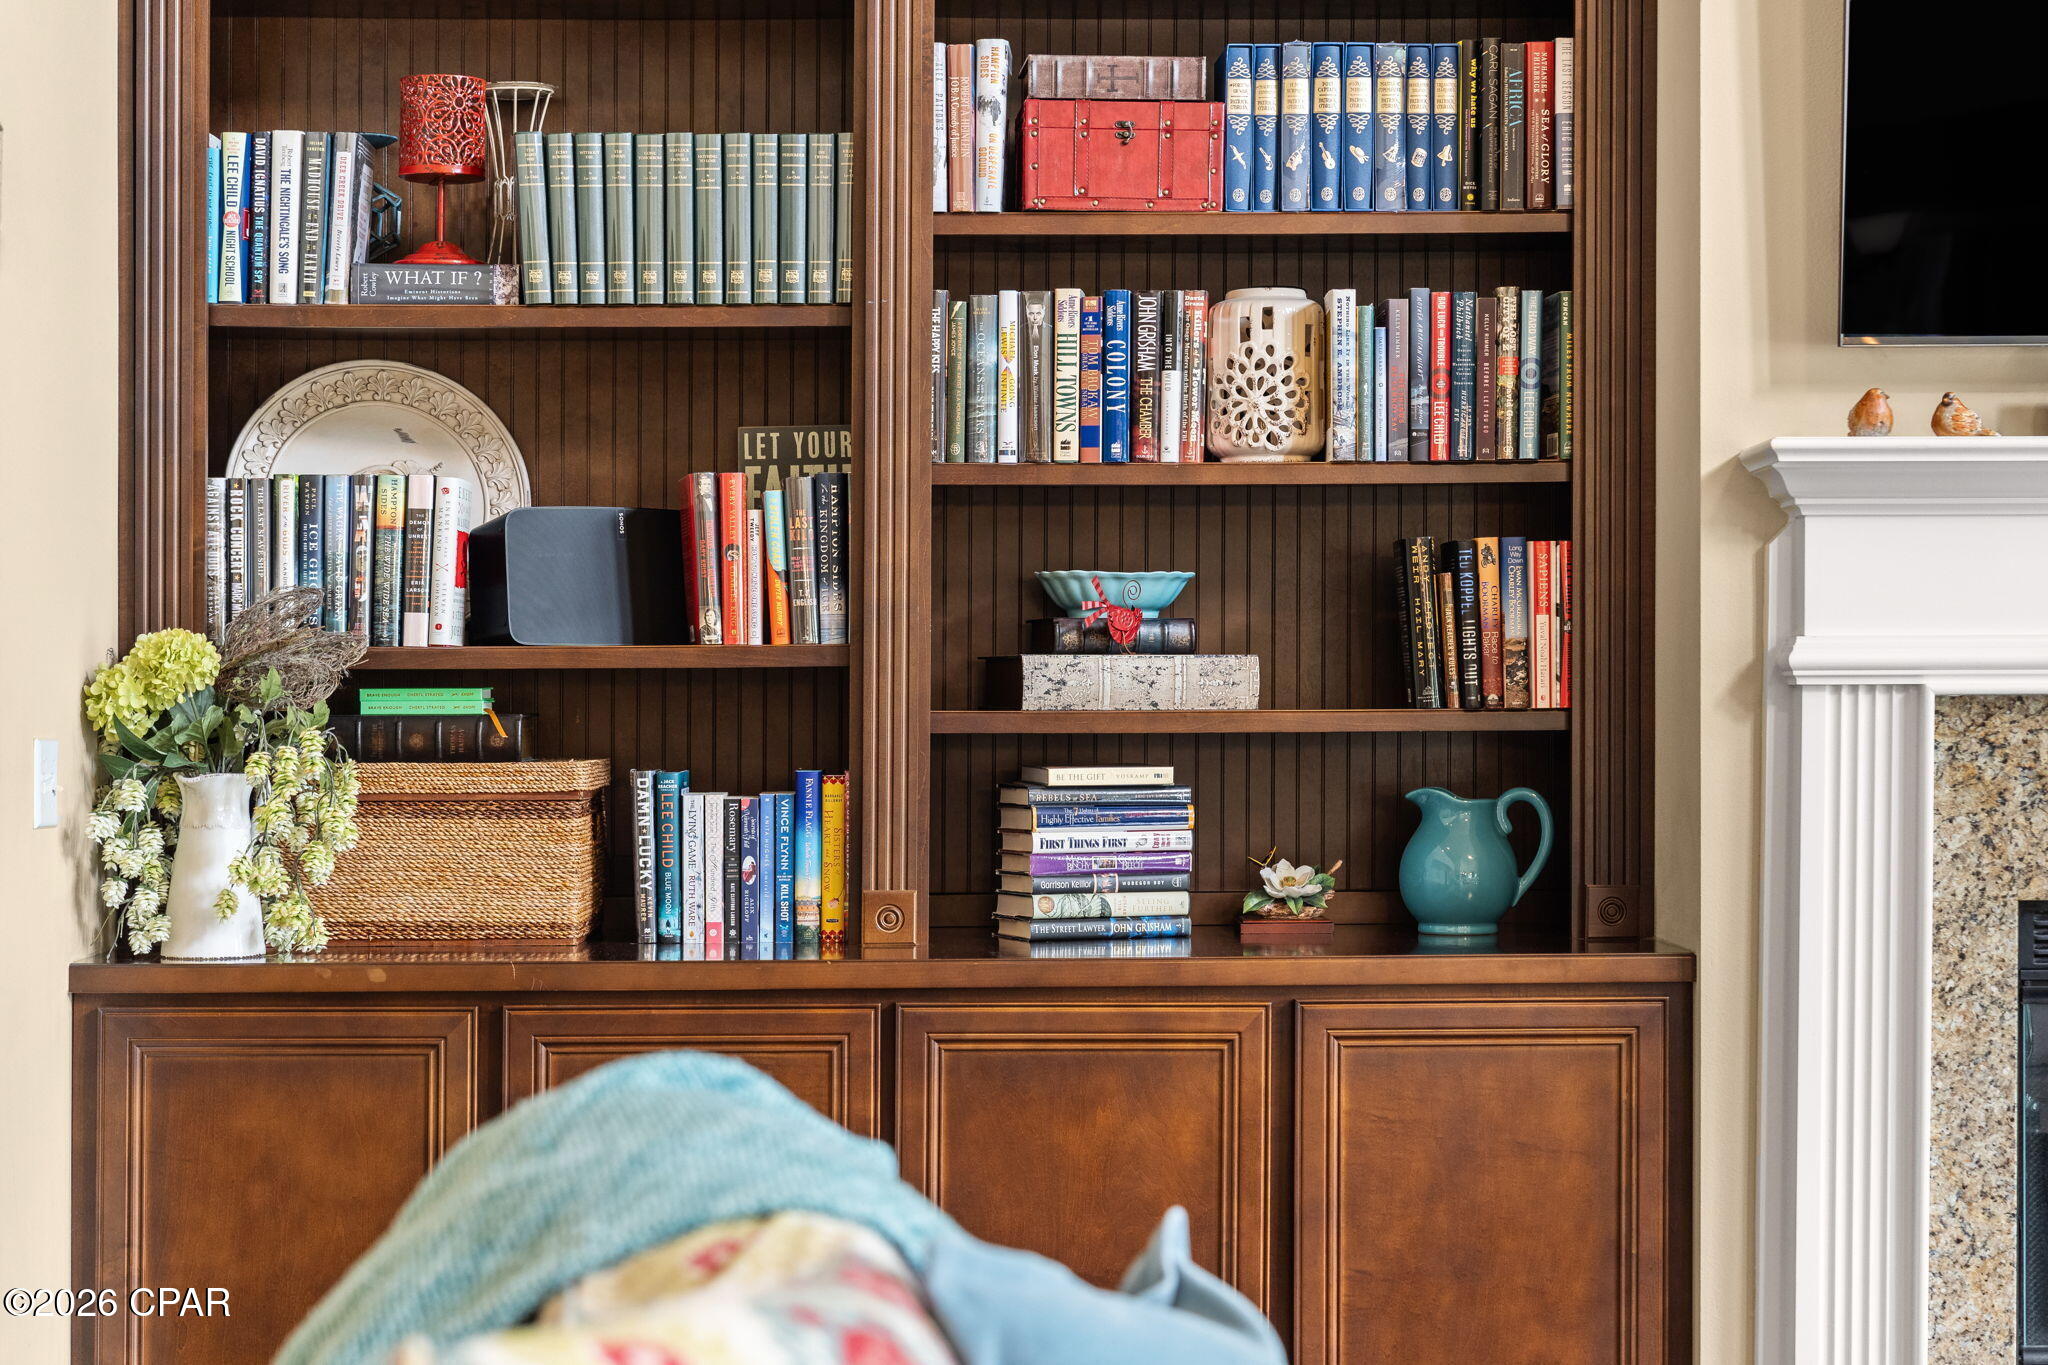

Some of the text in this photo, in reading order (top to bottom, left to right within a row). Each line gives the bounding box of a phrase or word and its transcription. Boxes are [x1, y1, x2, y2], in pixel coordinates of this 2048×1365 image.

[979, 55, 990, 79] SIDES
[990, 46, 1001, 84] HAMPTON
[1488, 44, 1498, 119] CARL SAGAN
[1468, 58, 1478, 128] why we hate us
[1508, 67, 1523, 127] AFRICA
[1561, 42, 1573, 176] THE LAST SEASON ERIC BLEHM
[227, 155, 239, 174] LEE
[1540, 109, 1550, 184] SEA of GLORY
[225, 176, 239, 208] CHILD
[253, 138, 267, 284] DAVID IGNATIUS THE QUANTUM SPY
[225, 230, 236, 253] NIGHT
[278, 169, 292, 274] THE NIGHTINGALE'S SONG
[303, 157, 322, 284] MADHOUSE END EARTH
[224, 255, 236, 287] SCHOOL
[360, 273, 369, 297] Robert
[369, 271, 379, 297] Cowley
[384, 270, 482, 286] WHAT IF ?
[1138, 295, 1157, 322] JOHN
[1455, 299, 1464, 340] Philbrick
[1465, 297, 1474, 342] Nathaniel
[1502, 296, 1510, 323] CITY
[1509, 296, 1517, 352] THE LOST
[1137, 324, 1157, 372] GRISHAM
[1165, 334, 1173, 353] INTO
[1183, 342, 1191, 366] Murders
[1502, 326, 1510, 342] OF
[1055, 333, 1078, 433] HILL TOWNS
[1087, 340, 1099, 420] TOM BROKAW
[1106, 339, 1126, 414] COLONY
[1164, 372, 1172, 392] WILD
[1165, 355, 1173, 369] THE
[1523, 296, 1537, 438] THE HARD WAY LEE CHILD
[1139, 377, 1153, 395] THE
[1182, 390, 1190, 411] Birth
[1138, 397, 1153, 441] CHAMBER
[743, 430, 851, 460] LET YOUR
[230, 489, 243, 602] ROCK CONCERT MARC
[309, 523, 319, 551] ICE
[1411, 545, 1425, 676] WEIR HAIL MARY
[1421, 545, 1435, 670] ANDY PROJECT
[1458, 548, 1478, 686] TED KOPPEL LIGHTS OUT
[1481, 581, 1491, 657] BOORMAN Dakar
[1490, 585, 1499, 665] CHARLEY Race to
[1539, 553, 1549, 688] SAPIENS Yuval Noah Harari
[1445, 607, 1455, 675] JACK REACHER'S RULES
[687, 810, 697, 839] LYING
[726, 802, 739, 853] Rosemary
[805, 777, 814, 838] FANNIE FLAGG
[1041, 815, 1064, 825] Highly
[1064, 814, 1095, 824] Effective
[1095, 814, 1121, 823] Families
[636, 777, 653, 891] DAMN LUCKY
[661, 793, 674, 914] LEE CHILD BLUE MOON
[687, 840, 697, 869] GAME
[1040, 836, 1129, 850] FIRST THINGS FIRST
[780, 798, 789, 922] VINCE FLYNN KILL SHOT
[688, 902, 696, 926] WARE
[1033, 922, 1172, 934] THE STREET LAWYER JOHN GRISHAM
